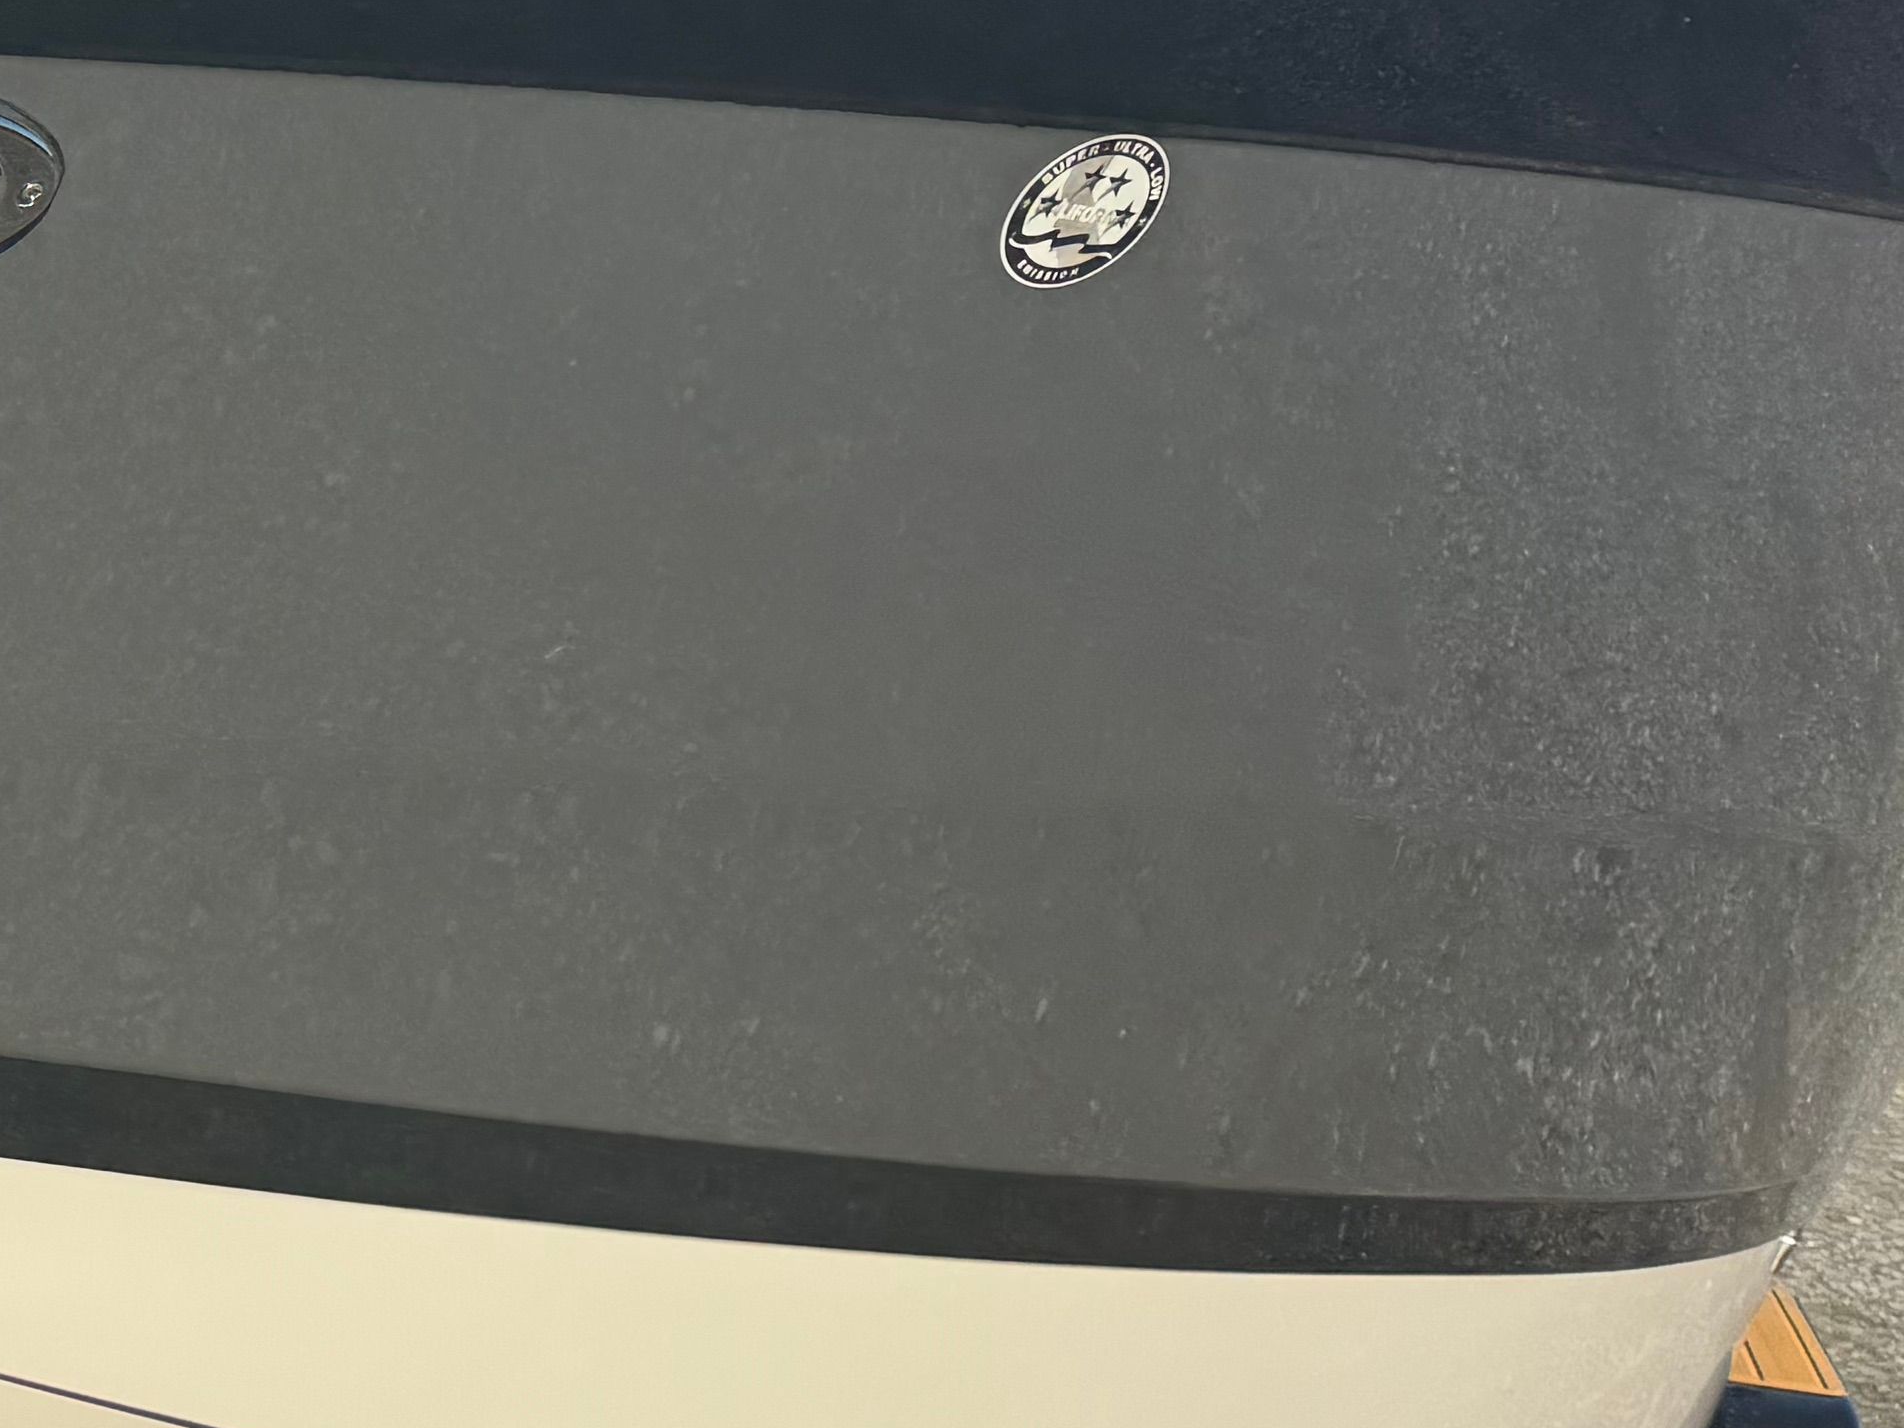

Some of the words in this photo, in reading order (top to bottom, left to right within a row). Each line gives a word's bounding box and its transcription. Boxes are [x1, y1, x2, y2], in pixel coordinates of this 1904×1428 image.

[1041, 144, 1101, 185] SUPER
[1113, 140, 1155, 164] ULTRA
[1016, 258, 1081, 282] EMISSION
